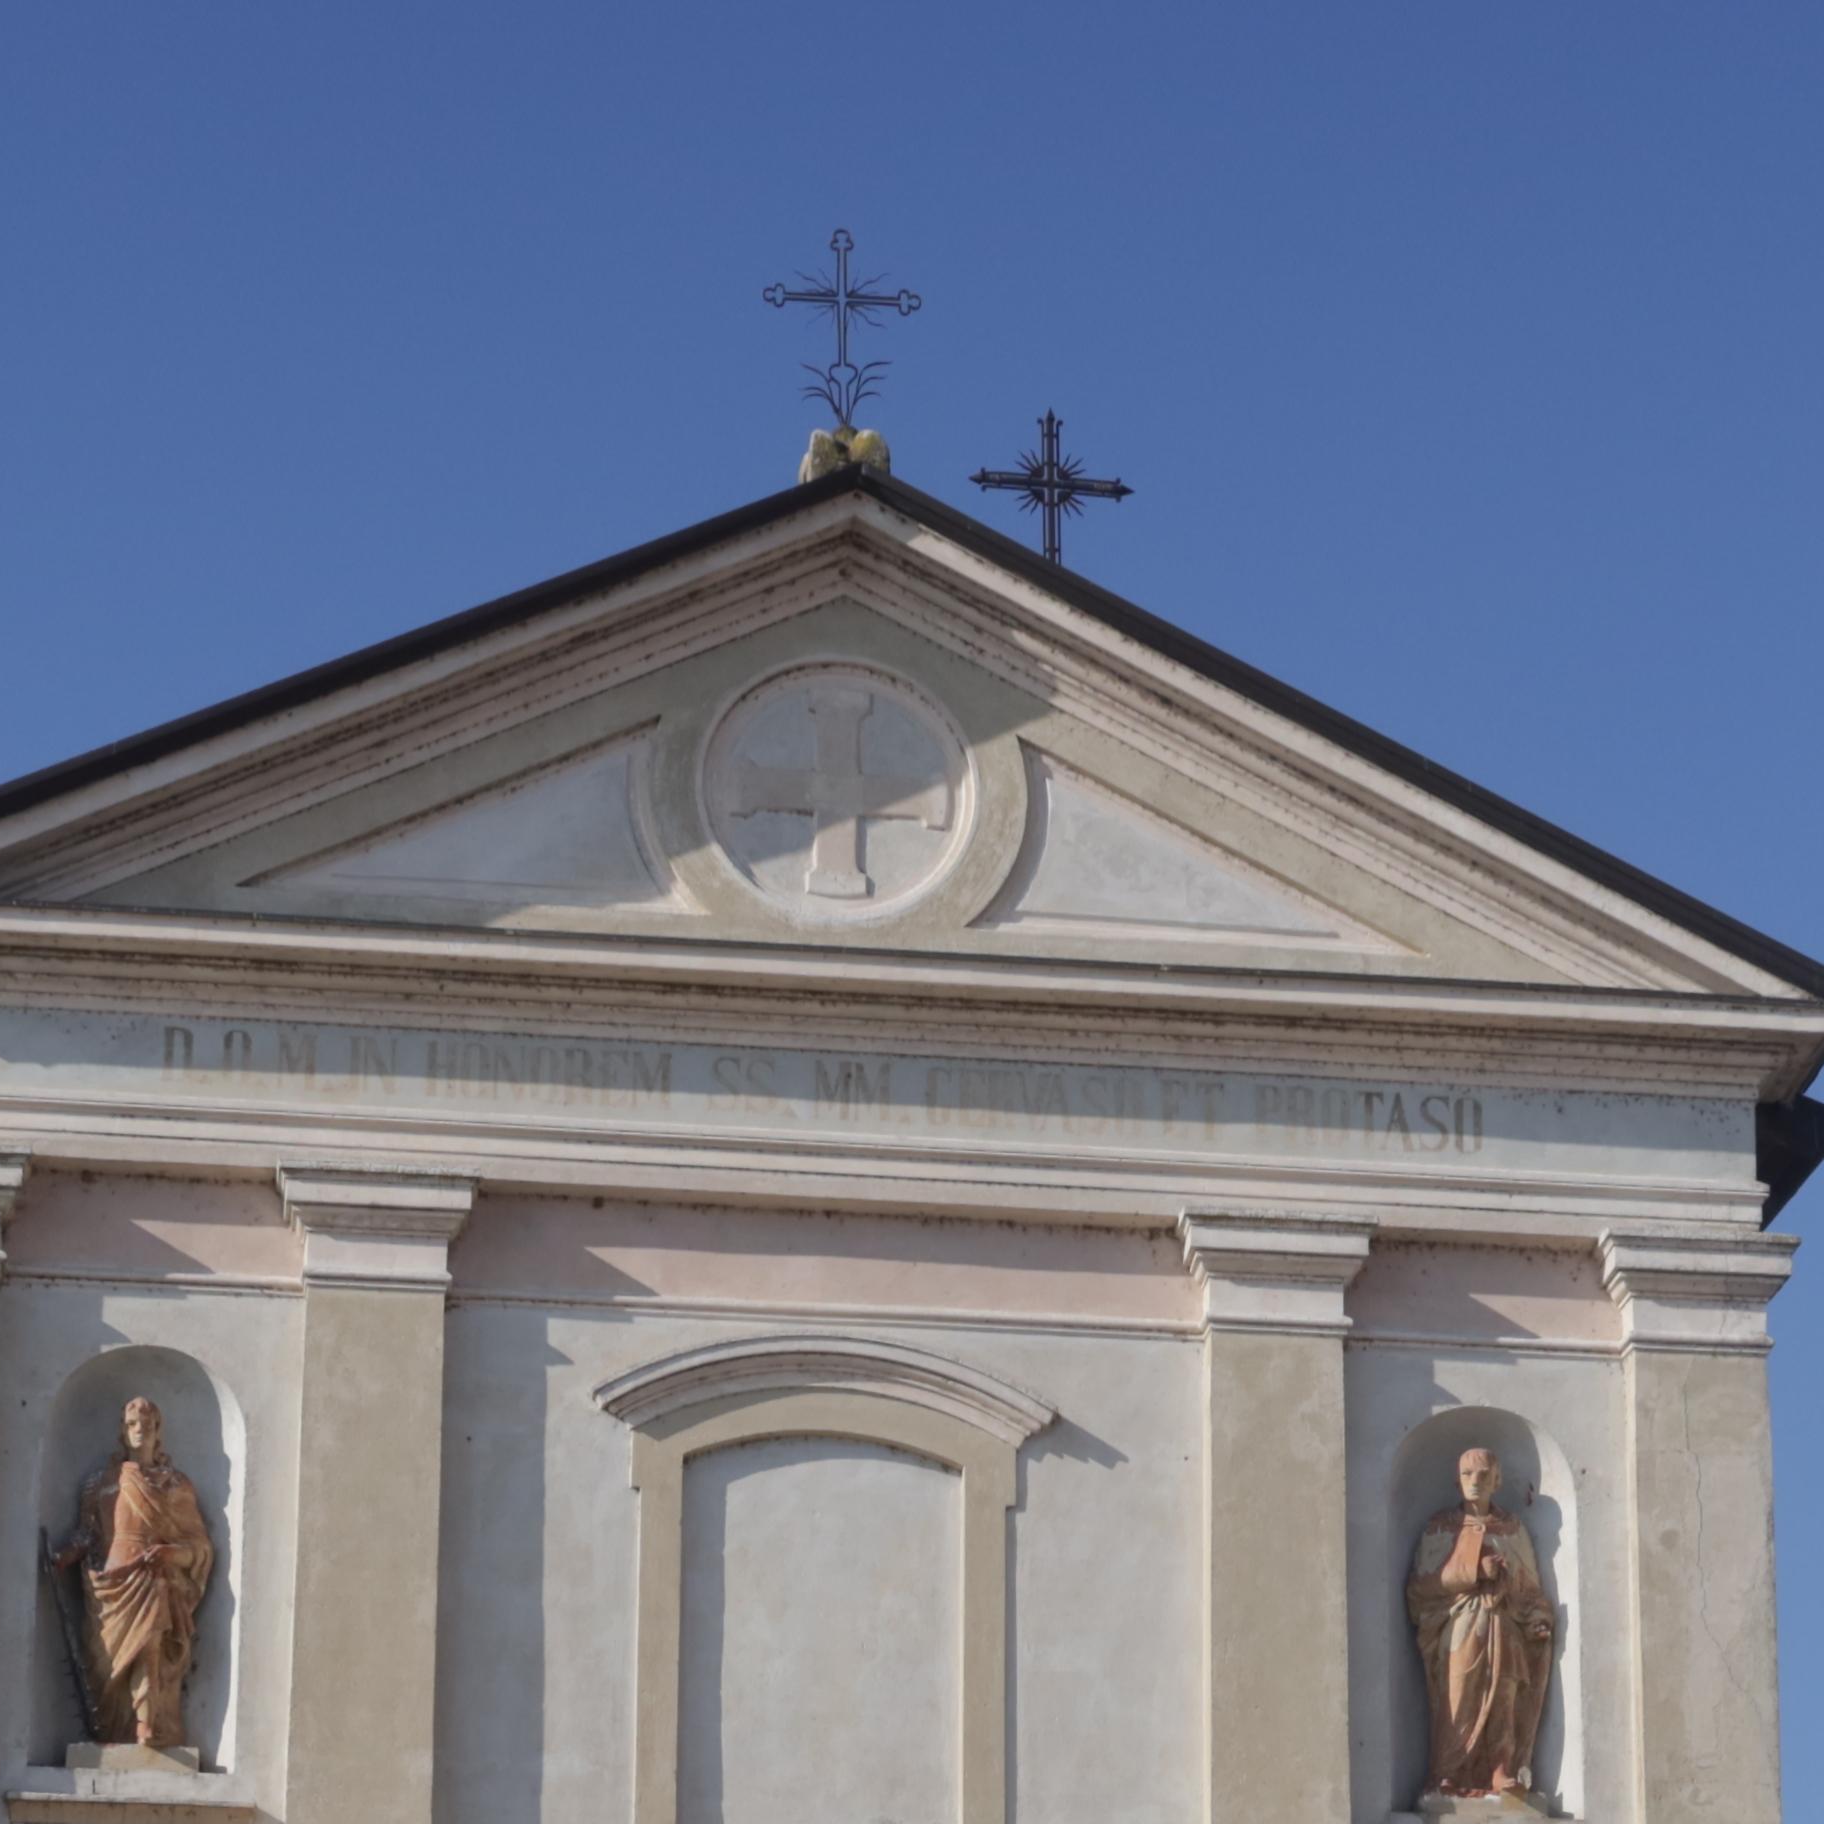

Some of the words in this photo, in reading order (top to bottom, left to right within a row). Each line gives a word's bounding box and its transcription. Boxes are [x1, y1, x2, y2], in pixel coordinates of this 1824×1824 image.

[348, 1035, 398, 1096] IN
[425, 1040, 673, 1109] HONOREM
[1161, 1080, 1225, 1142] ET
